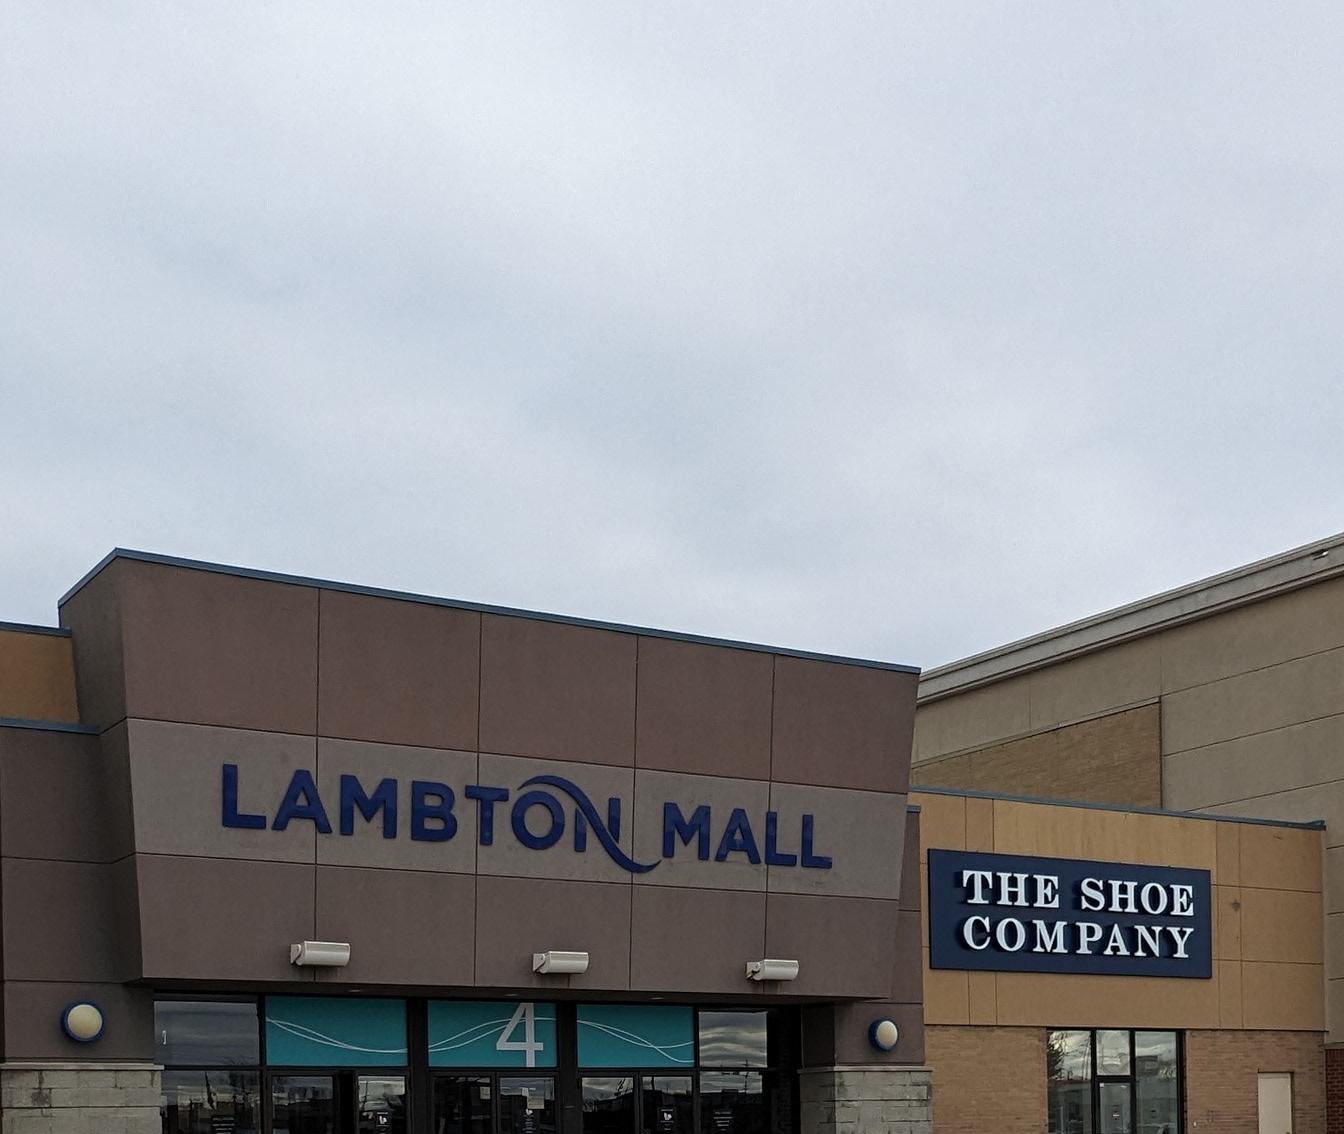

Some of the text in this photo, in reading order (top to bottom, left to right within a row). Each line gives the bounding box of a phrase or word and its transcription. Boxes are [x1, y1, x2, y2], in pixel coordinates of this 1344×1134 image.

[221, 763, 833, 873] LAMBTON MALL
[962, 870, 1194, 915] THE SHOE
[962, 915, 1194, 958] COMPANY
[495, 1001, 545, 1068] 4
